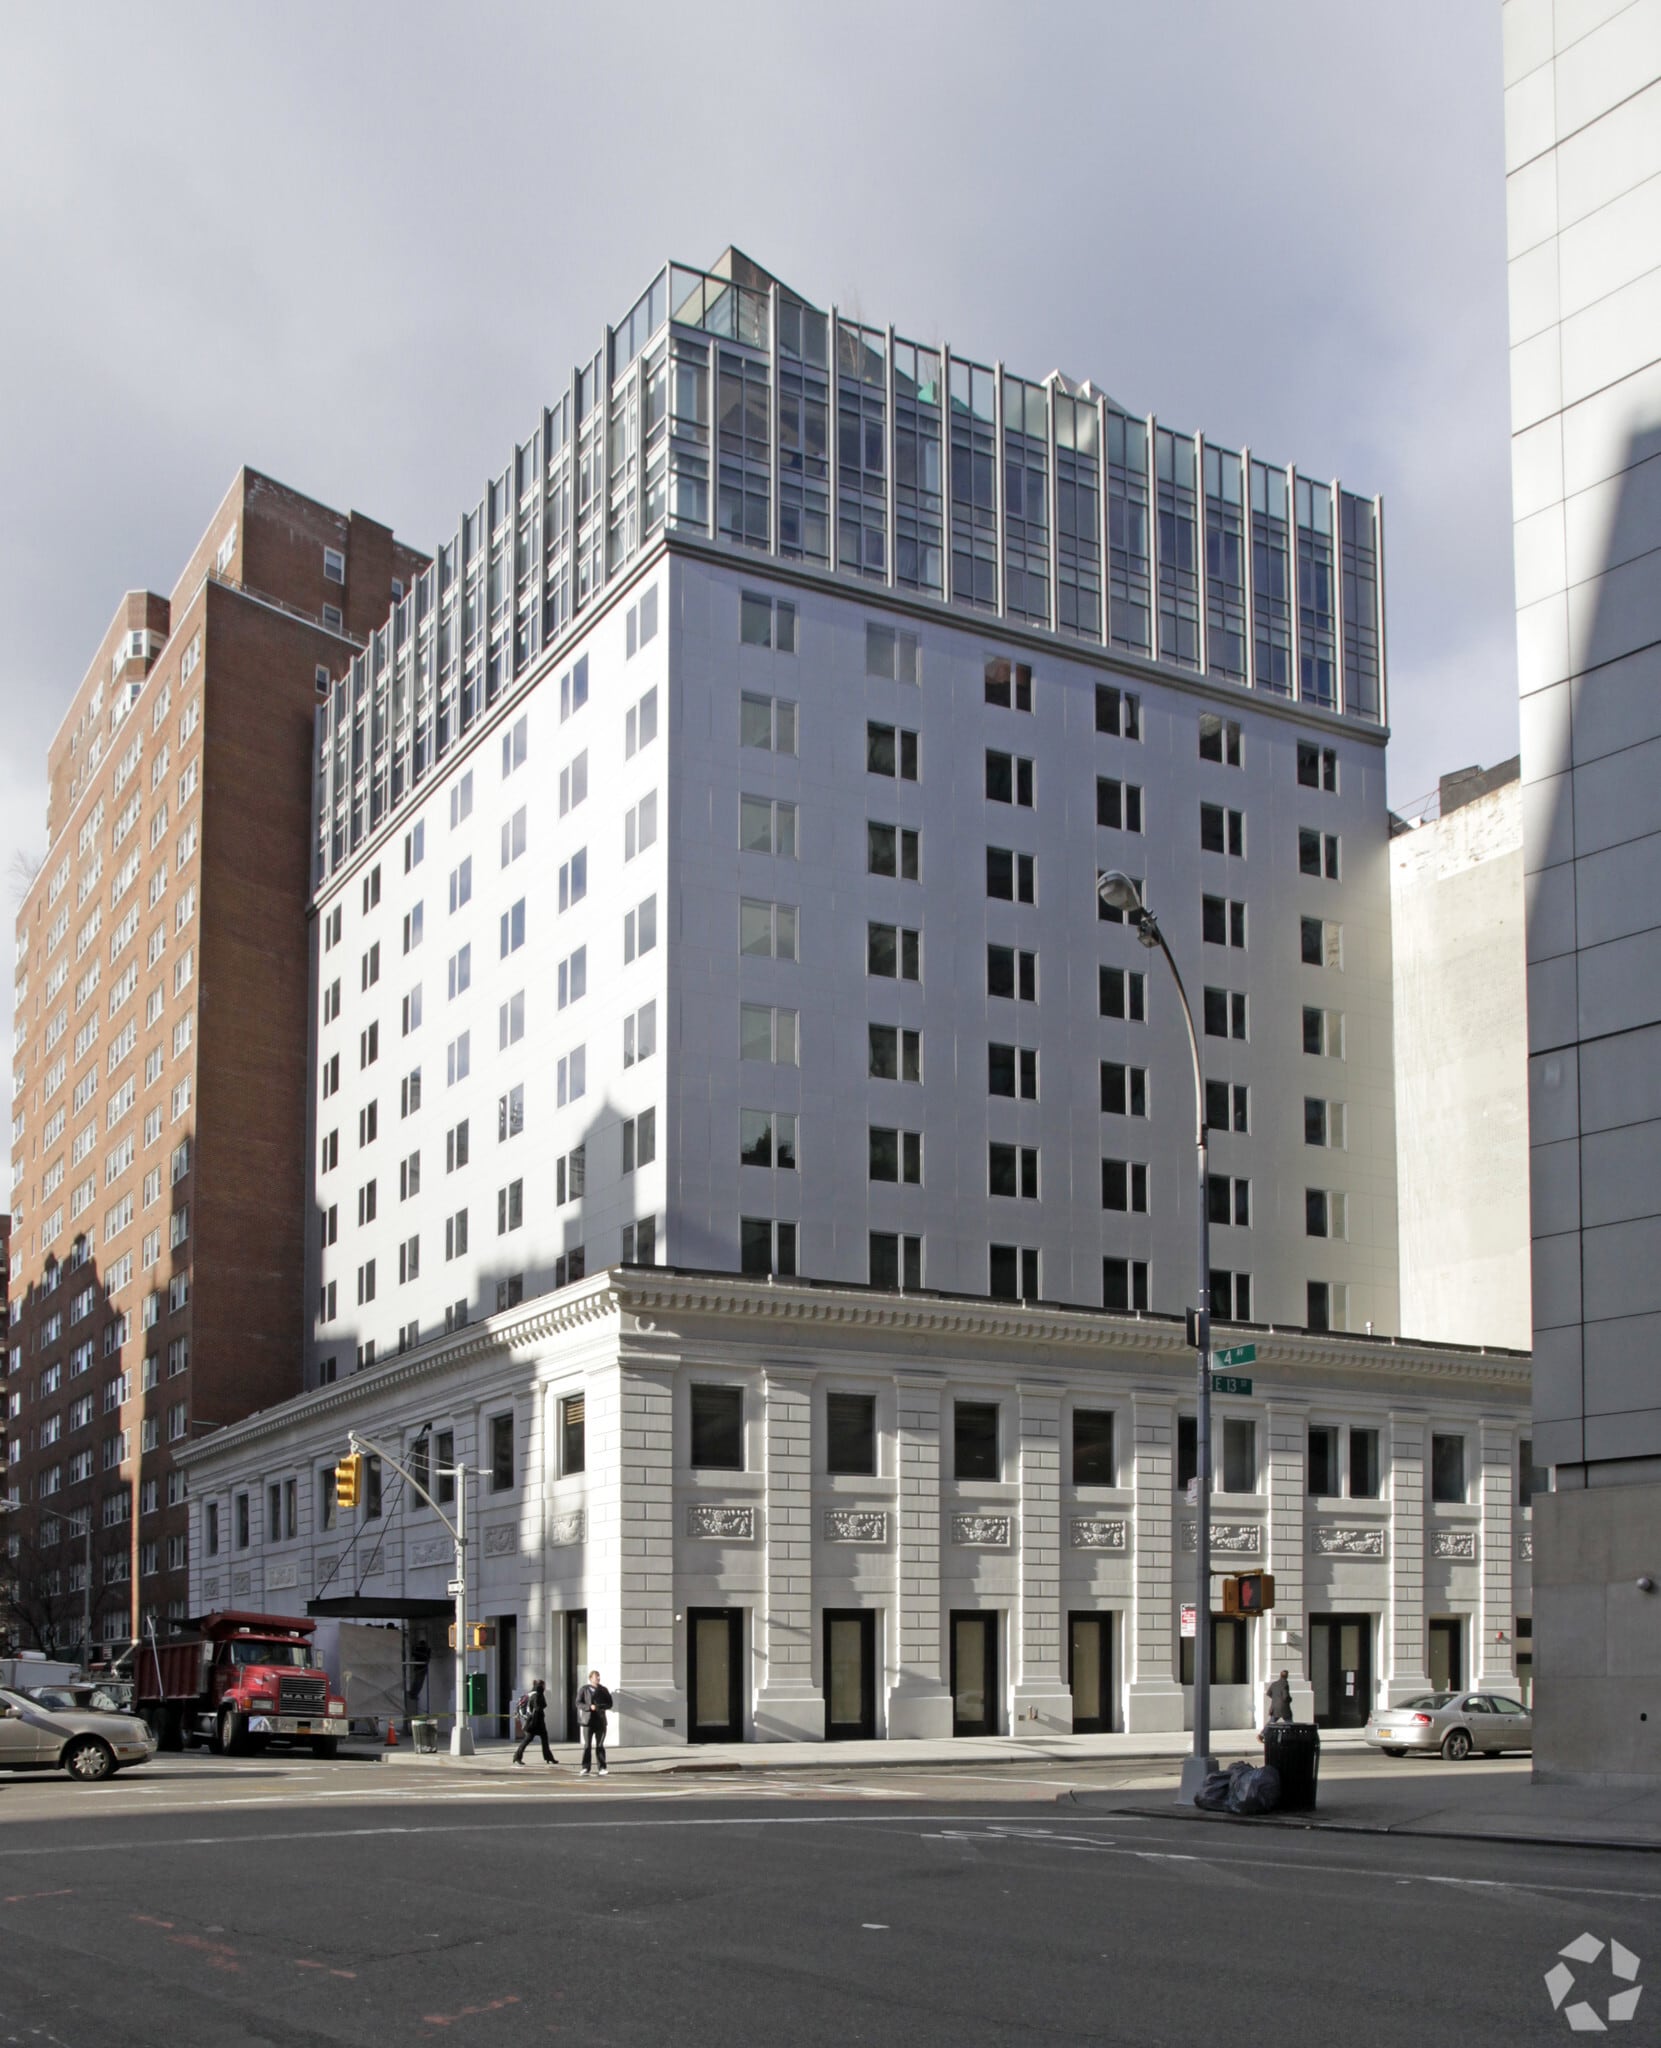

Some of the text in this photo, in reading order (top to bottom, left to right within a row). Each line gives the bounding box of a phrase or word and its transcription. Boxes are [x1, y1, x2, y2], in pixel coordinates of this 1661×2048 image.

[1223, 1350, 1232, 1365] 4
[1215, 1377, 1222, 1391] E
[1226, 1378, 1237, 1392] 13
